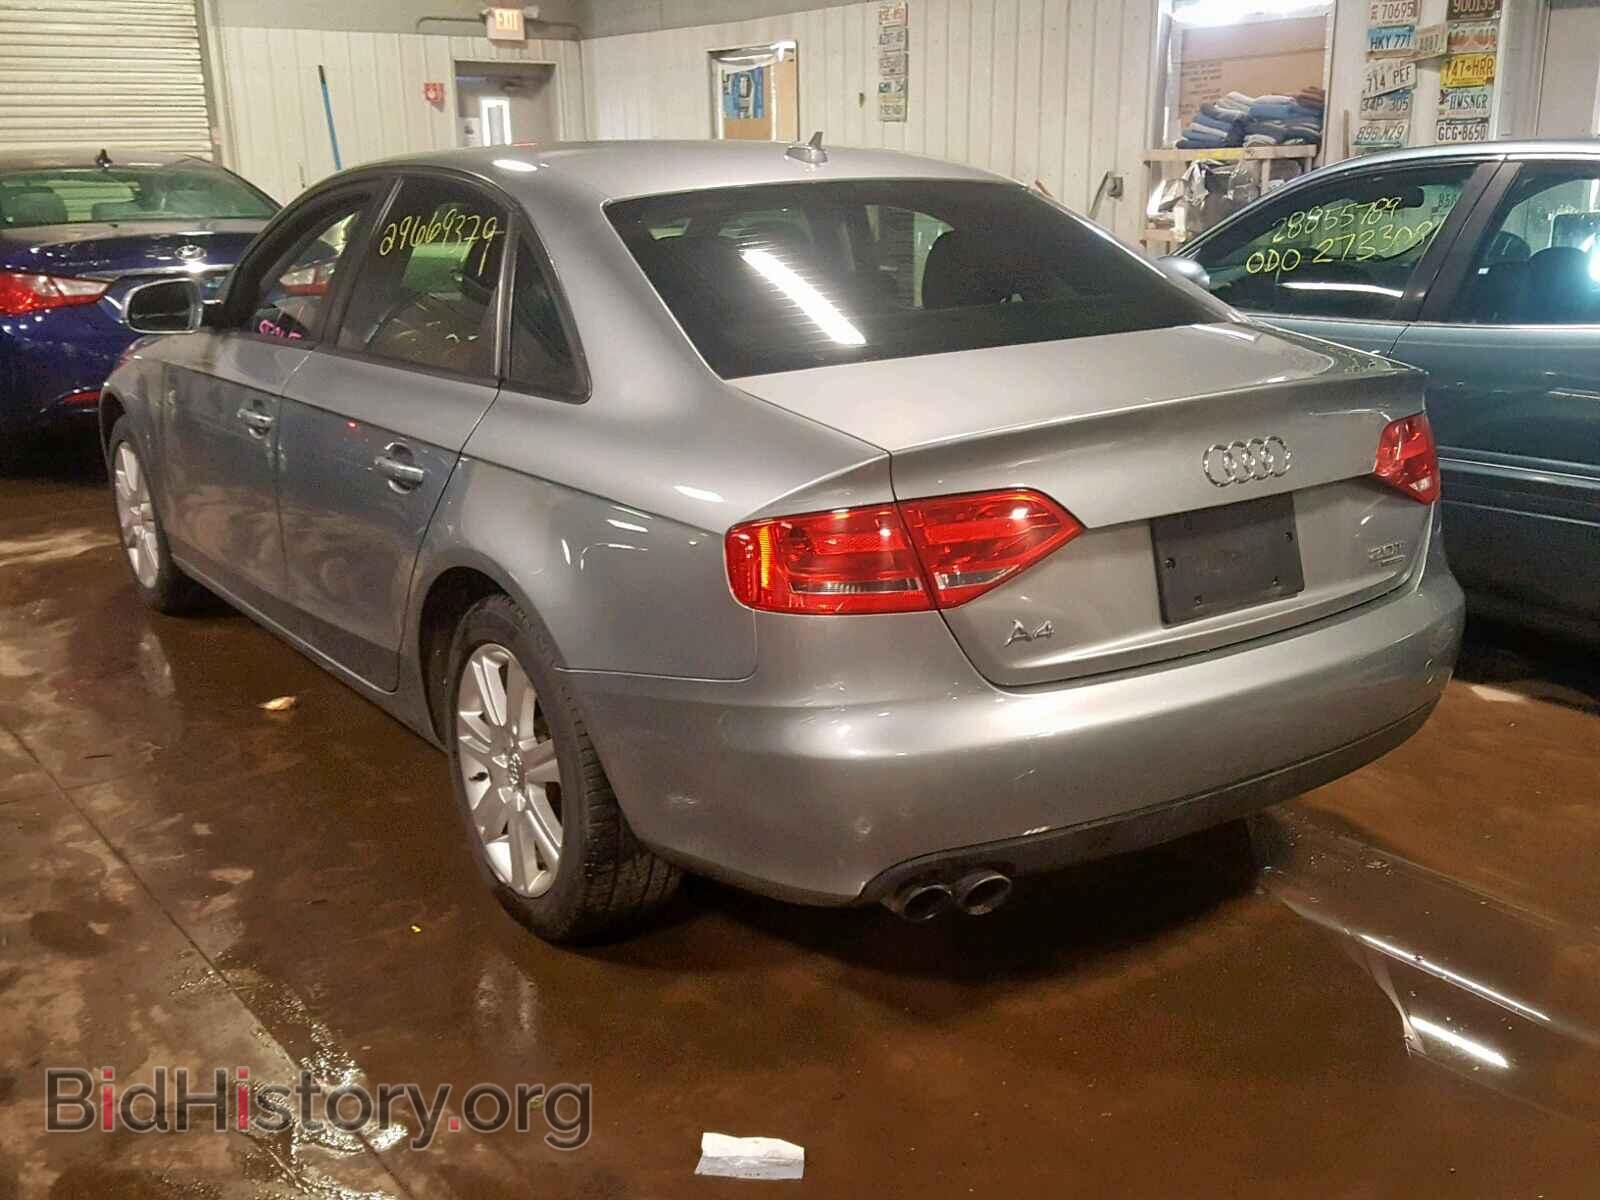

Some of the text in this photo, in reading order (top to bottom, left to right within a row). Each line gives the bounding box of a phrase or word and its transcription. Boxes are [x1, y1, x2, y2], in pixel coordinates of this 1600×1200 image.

[379, 208, 505, 277] 29669379
[1271, 197, 1402, 243] 28855789
[1003, 619, 1054, 648] A4
